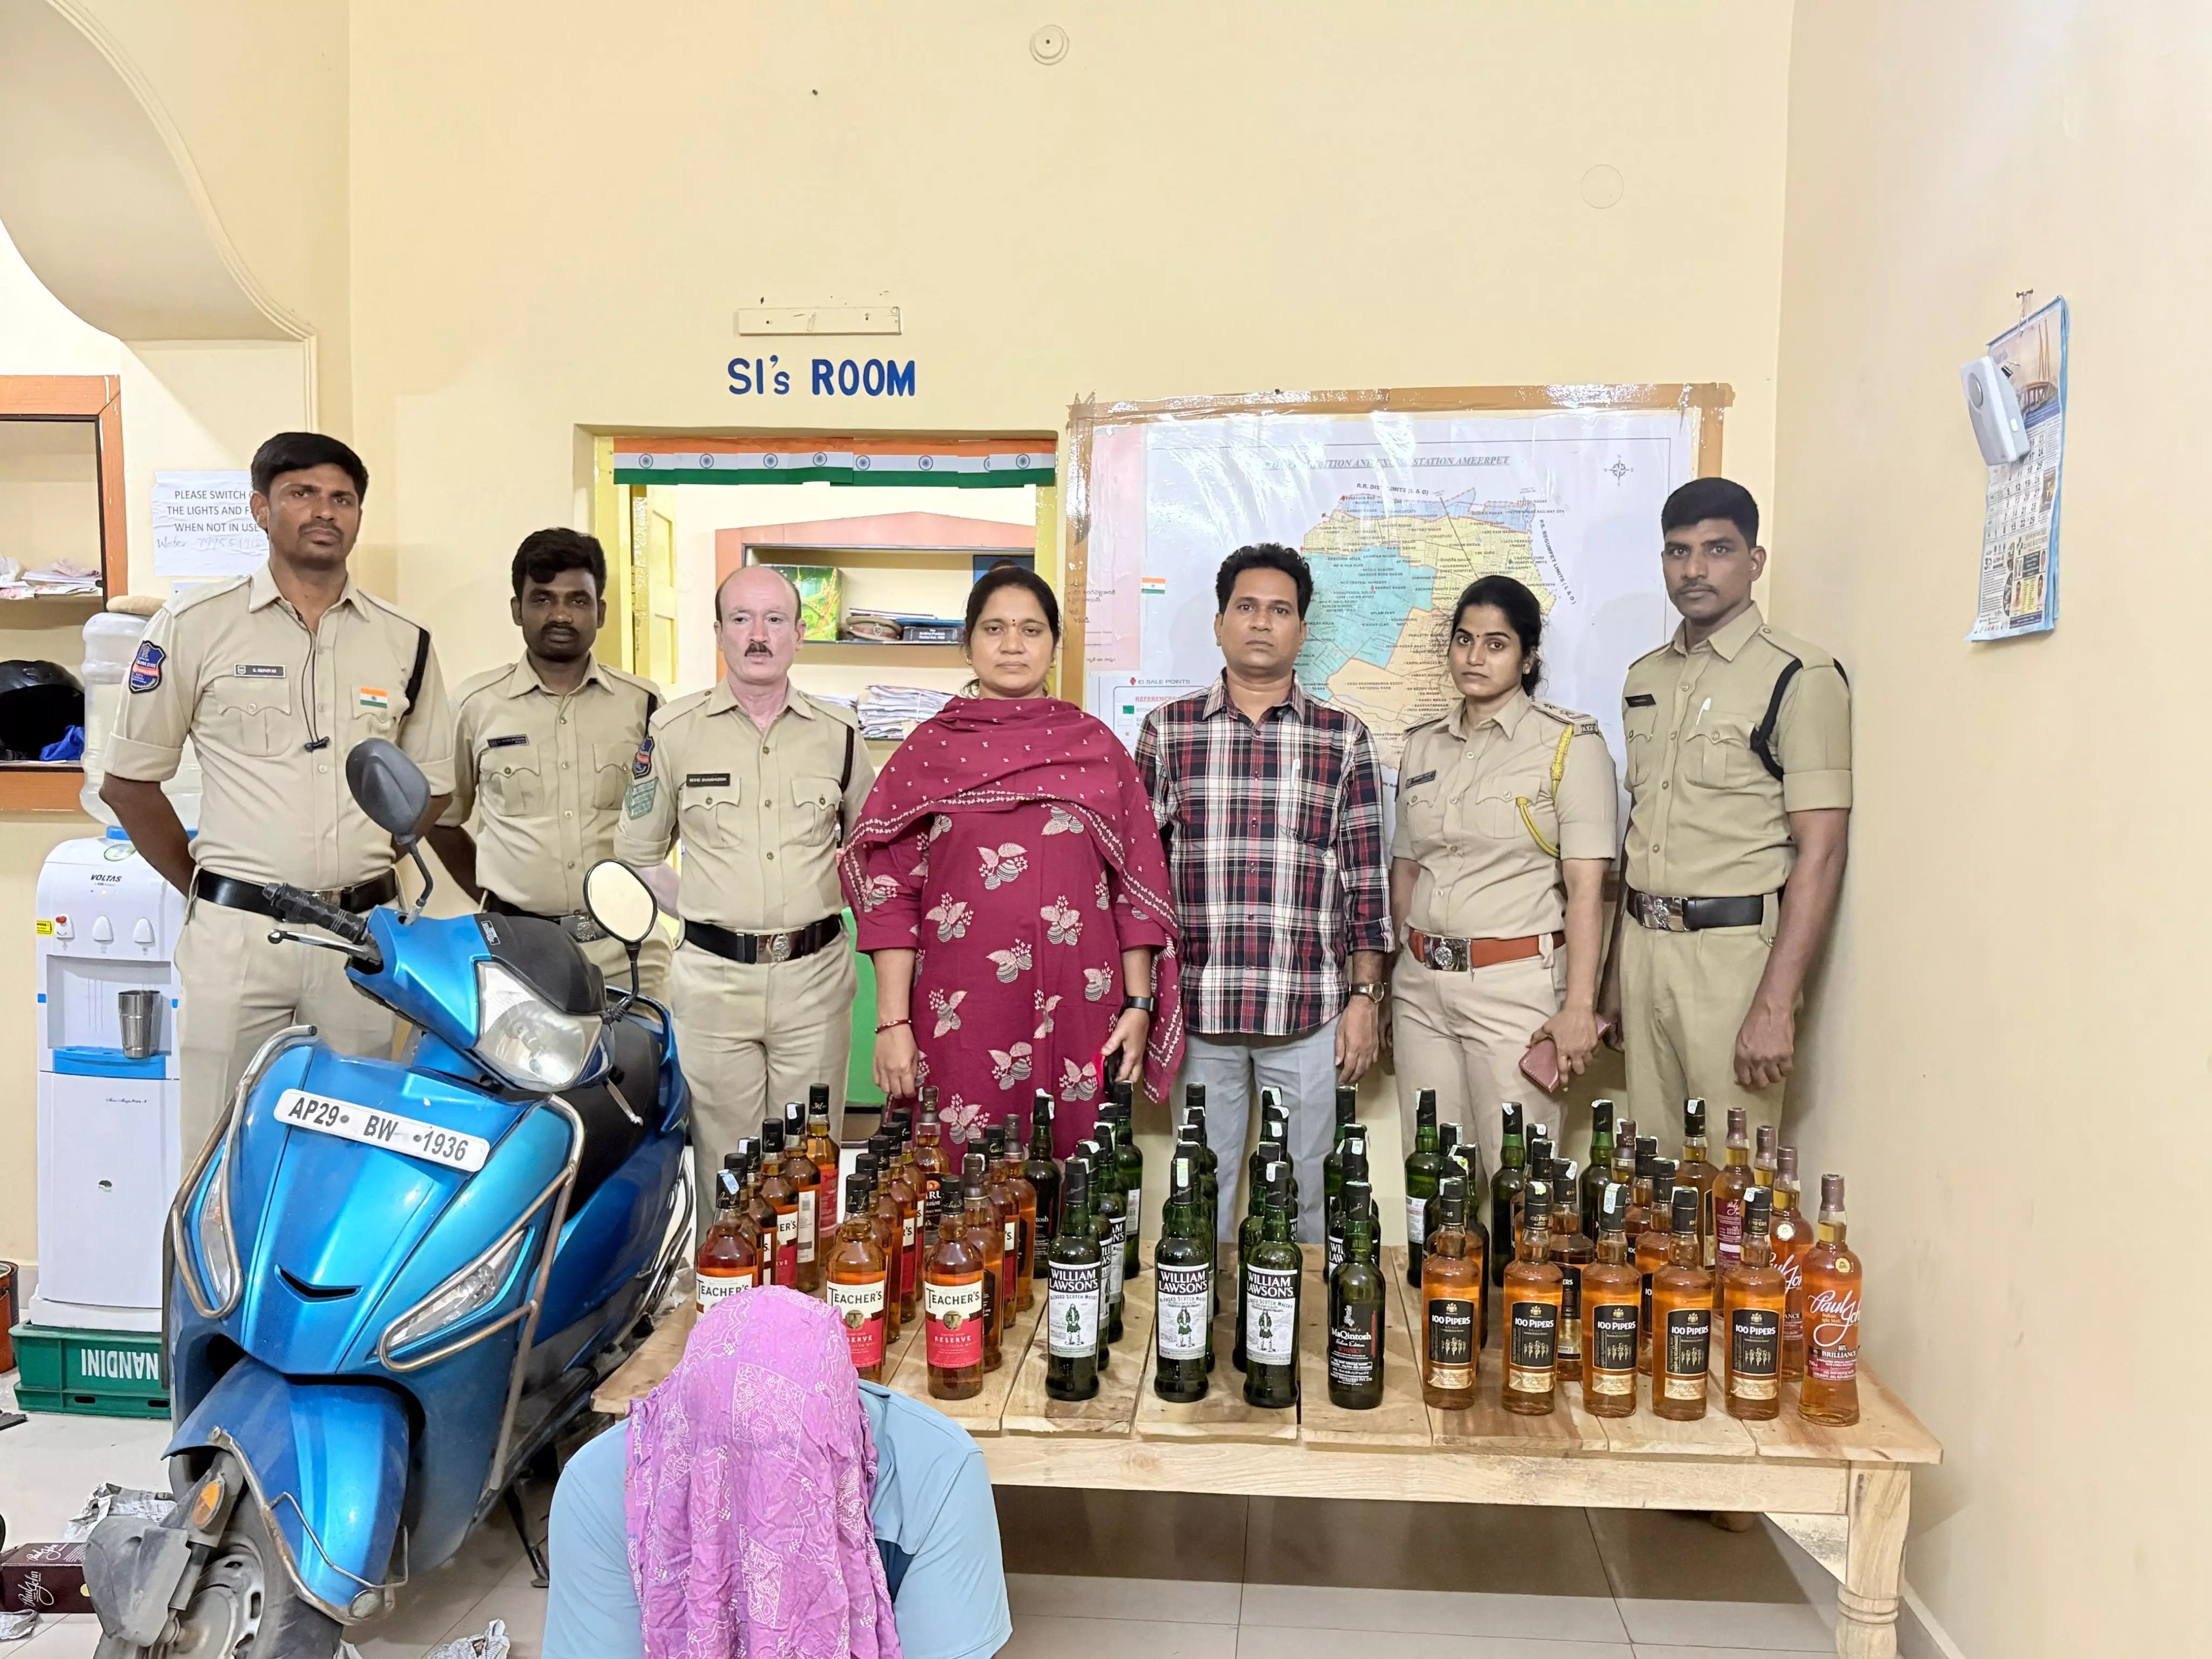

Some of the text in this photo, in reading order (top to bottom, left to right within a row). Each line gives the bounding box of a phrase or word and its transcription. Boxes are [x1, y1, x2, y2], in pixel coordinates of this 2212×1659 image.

[727, 354, 915, 396] SI's ROOM
[1413, 457, 1455, 466] STATION
[1455, 456, 1510, 466] AMEERPET
[174, 490, 208, 500] PLEASE
[209, 490, 246, 500] SWITCH
[166, 506, 185, 515] THE
[187, 506, 219, 515] LIGHTS
[221, 506, 242, 515] AND
[174, 523, 260, 532] WHEN NOT IN USE
[1542, 530, 1557, 563] BEGUMPET
[1553, 562, 1565, 583] LIMITS
[90, 874, 123, 883] VOLTAS
[288, 1097, 469, 1161] AP29 BW 1936
[1050, 1267, 1097, 1282] WILLIAM
[1160, 1270, 1206, 1284] WILLIAM
[1247, 1271, 1291, 1287] WILLIAM
[697, 1279, 750, 1300] TEACHER'S
[1049, 1277, 1098, 1291] LAWSON'S
[1158, 1279, 1207, 1293] LAWSON'S
[1247, 1280, 1294, 1298] LAWSON'S
[828, 1286, 883, 1307] TEACHER'S
[926, 1287, 980, 1309] TEACHER'S
[1645, 1287, 1653, 1297] 10
[1808, 1289, 1853, 1314] Paul
[1432, 1314, 1471, 1326] 100 PIPERS
[1514, 1317, 1554, 1328] 100 PIPERS
[1597, 1320, 1636, 1331] 100 PIPERS
[1671, 1325, 1709, 1336] 100 PIPERS
[1735, 1324, 1776, 1336] 100 PIPERS
[847, 1335, 873, 1344] SERVE
[934, 1334, 973, 1344] RESERVE
[82, 1348, 159, 1381] NANDINI
